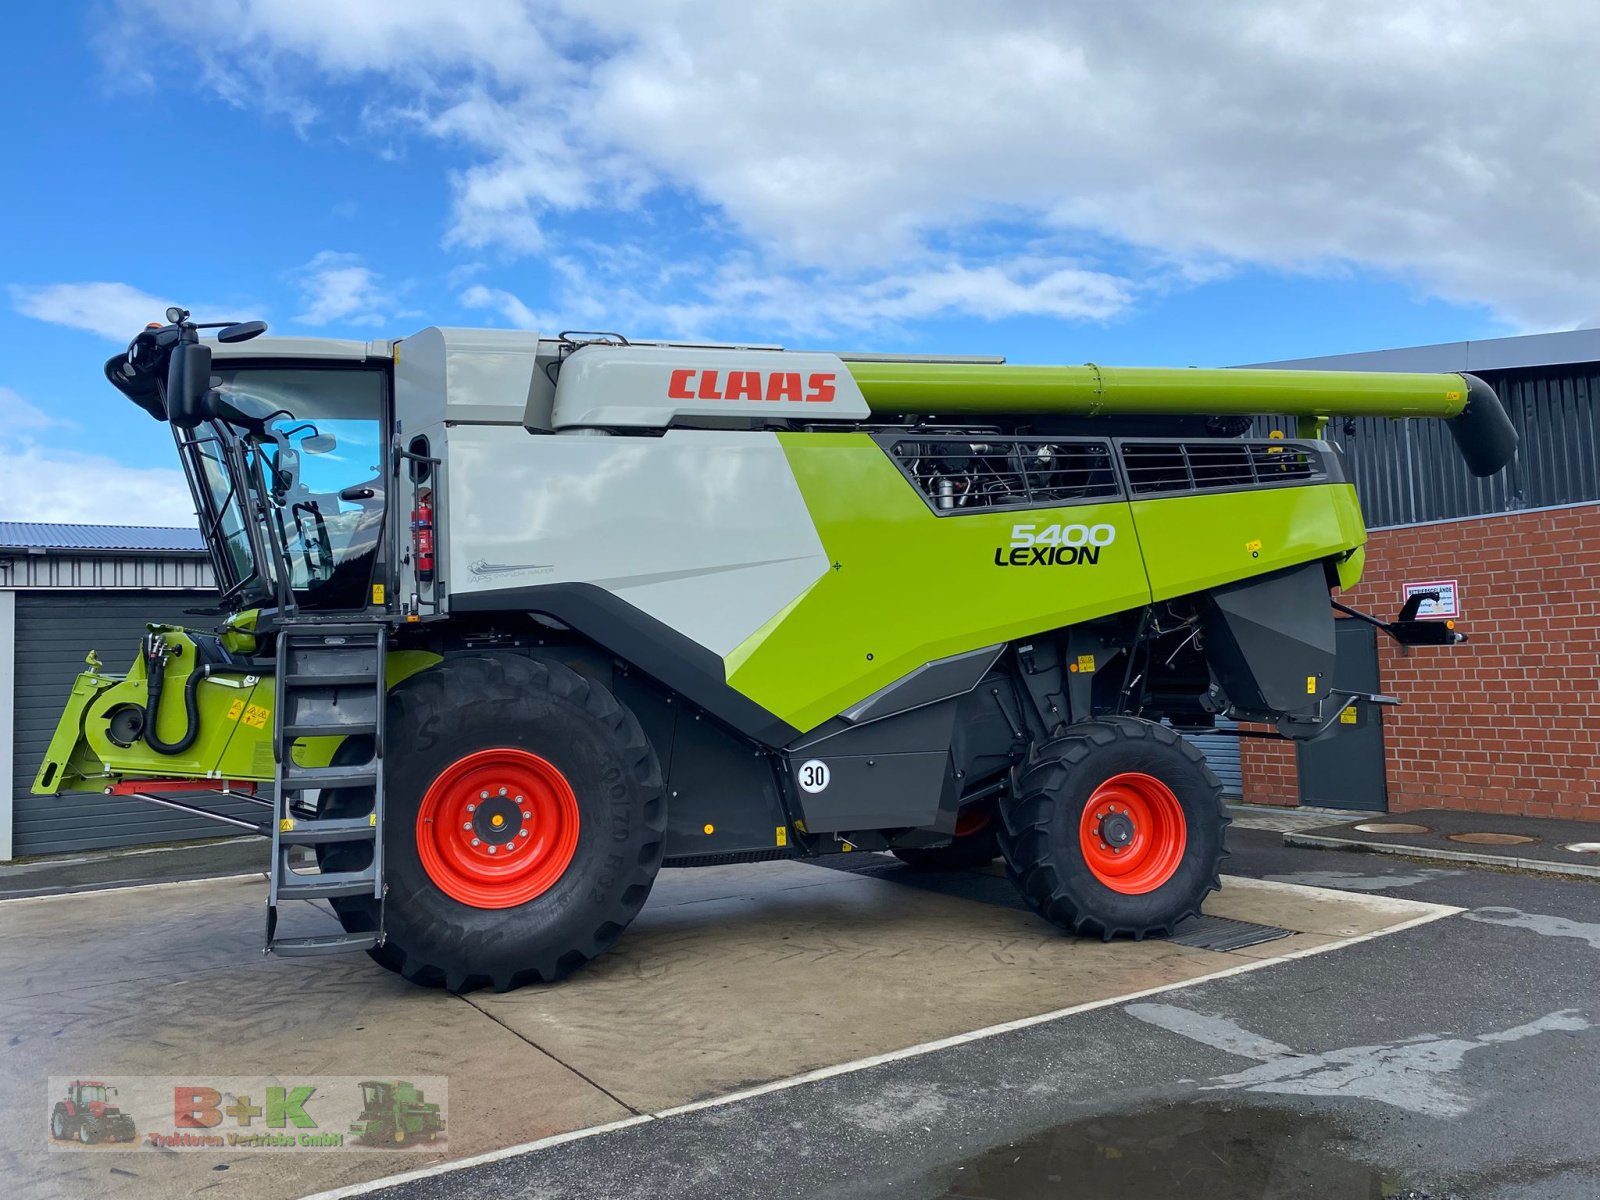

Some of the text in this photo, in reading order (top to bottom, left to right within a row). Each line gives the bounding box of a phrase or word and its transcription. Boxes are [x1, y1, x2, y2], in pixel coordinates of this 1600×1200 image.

[668, 369, 836, 402] CLAAS
[1010, 524, 1116, 547] 5400
[994, 546, 1101, 566] LEXION
[804, 766, 824, 786] 30
